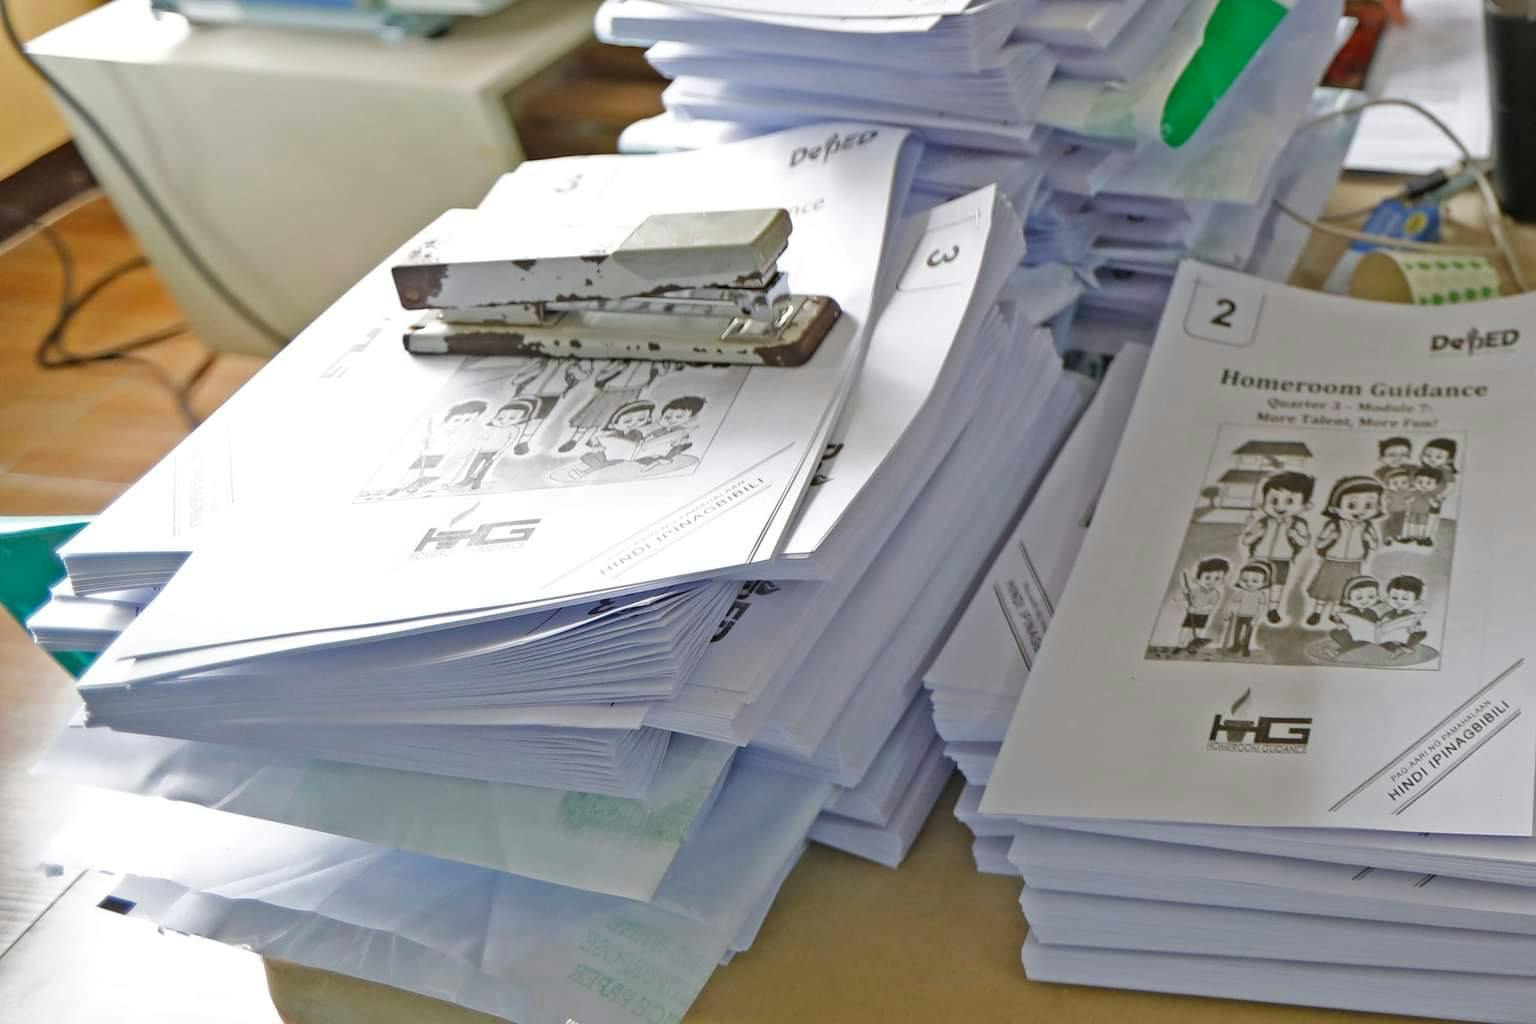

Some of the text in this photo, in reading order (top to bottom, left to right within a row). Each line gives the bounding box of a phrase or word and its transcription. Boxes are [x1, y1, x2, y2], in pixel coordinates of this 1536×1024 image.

[790, 130, 878, 167] DepED
[926, 243, 960, 268] 3
[1210, 299, 1237, 328] 2
[1430, 328, 1520, 355] DepED
[1221, 368, 1488, 399] Homeroom Guidance
[1267, 398, 1326, 411] Quarter
[1358, 402, 1412, 413] Module
[1256, 412, 1296, 424] More
[1301, 414, 1353, 428] Talent,
[1358, 416, 1397, 428] More
[1387, 700, 1511, 802] HINDI IPINAGBIBILI
